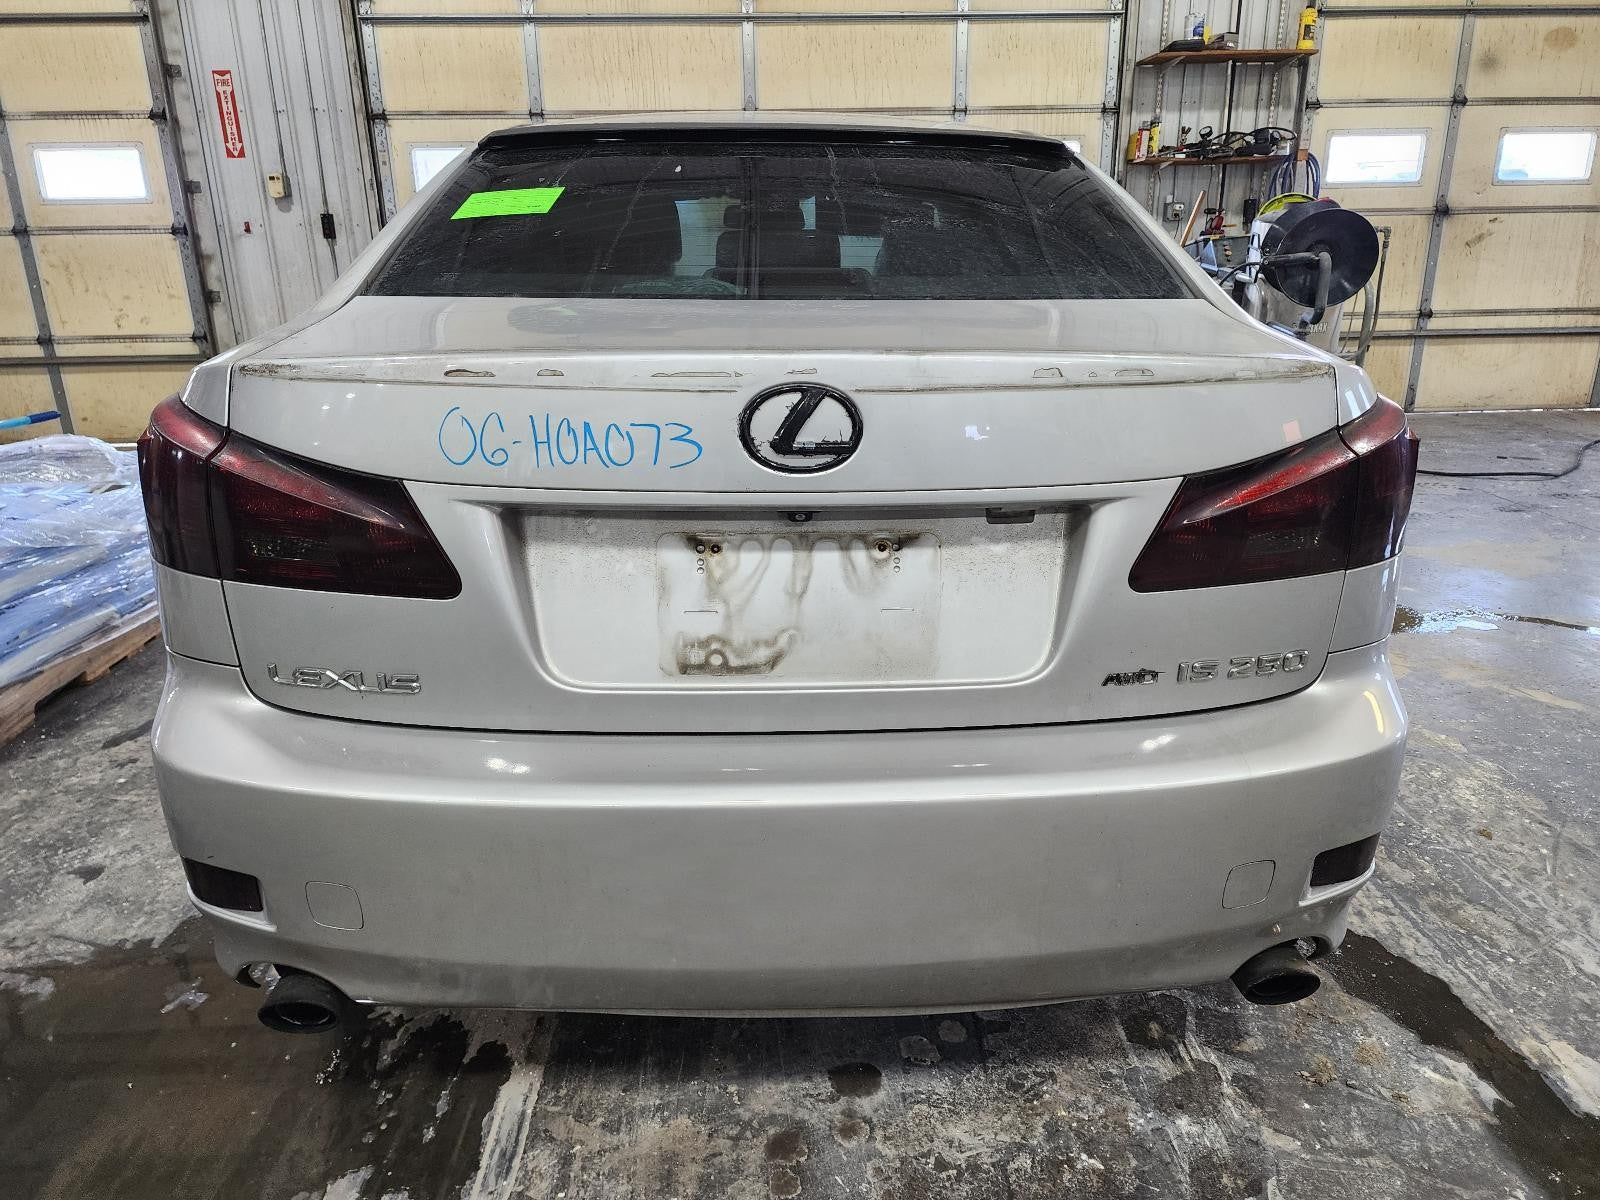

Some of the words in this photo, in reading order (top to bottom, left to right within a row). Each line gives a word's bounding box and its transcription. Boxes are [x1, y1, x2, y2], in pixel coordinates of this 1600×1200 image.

[215, 78, 231, 87] FIRE
[222, 90, 238, 152] EXTINGUISHER
[267, 663, 422, 694] LEXUS
[1176, 660, 1219, 684] IS
[1227, 650, 1309, 680] 250
